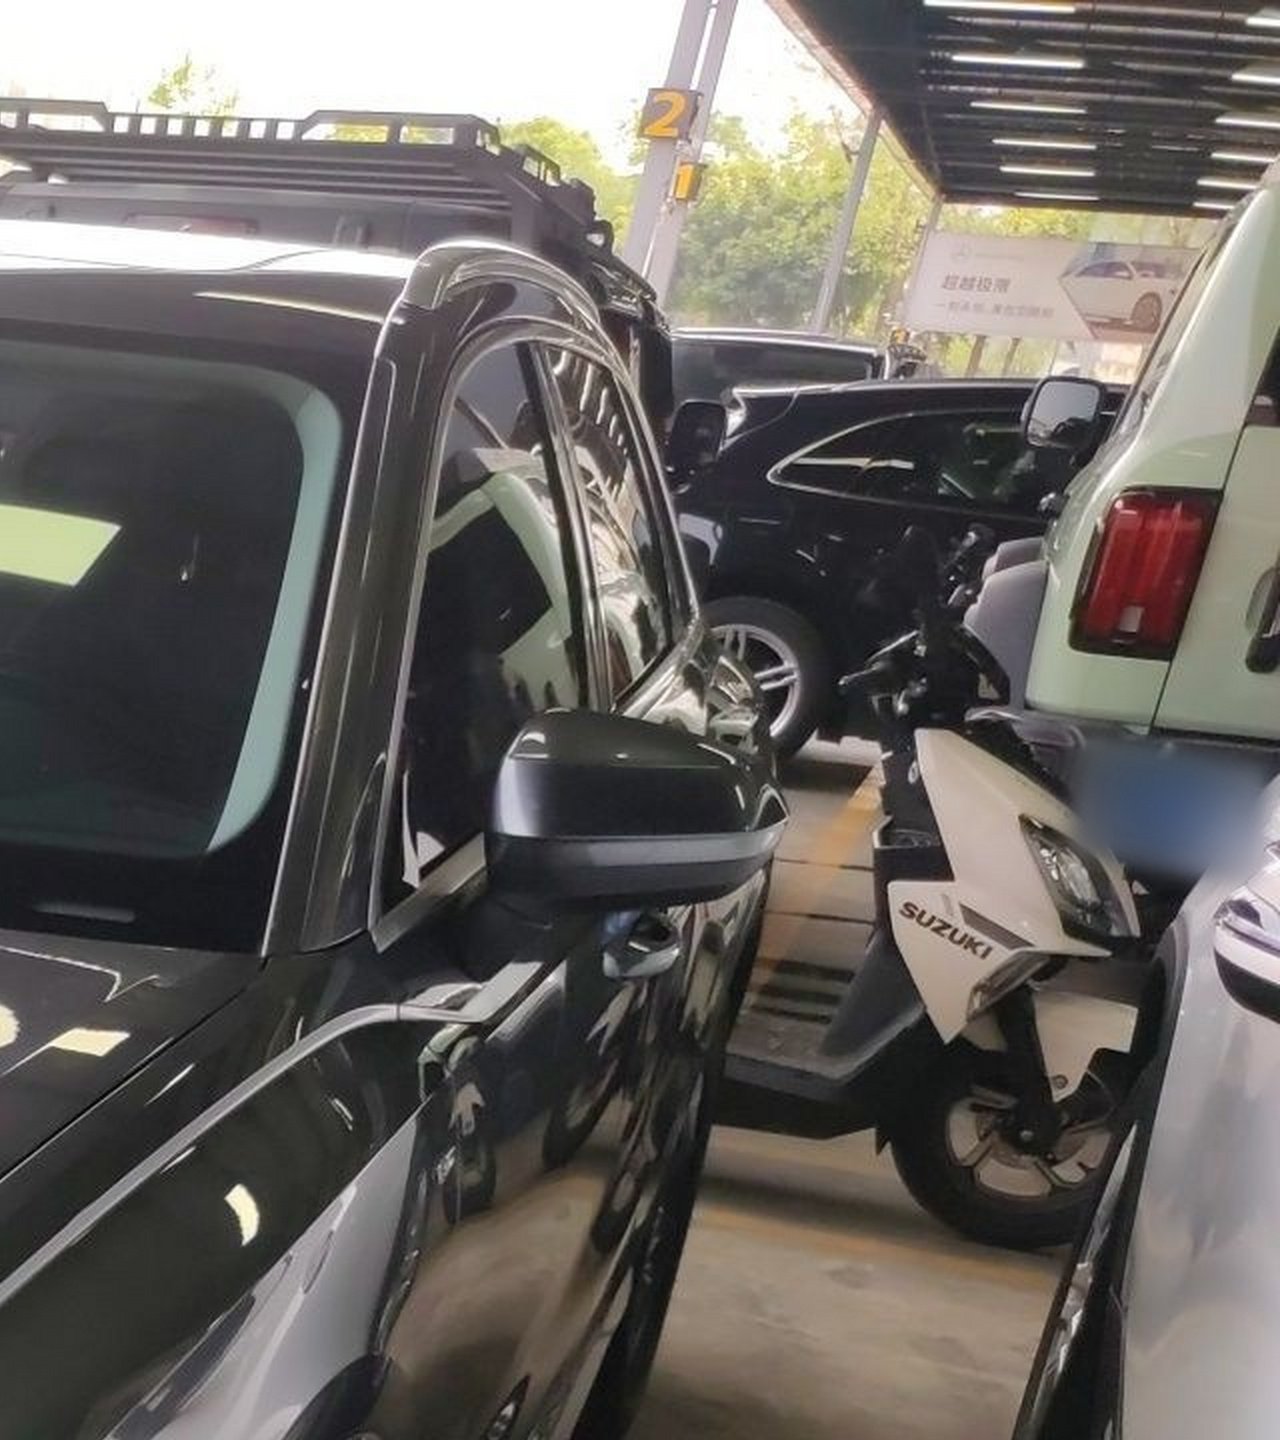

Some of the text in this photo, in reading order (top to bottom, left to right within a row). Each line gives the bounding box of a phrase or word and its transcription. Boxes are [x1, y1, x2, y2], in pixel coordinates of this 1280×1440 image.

[643, 90, 686, 137] 2
[673, 162, 694, 199] 1
[899, 901, 993, 960] SUZUKI
